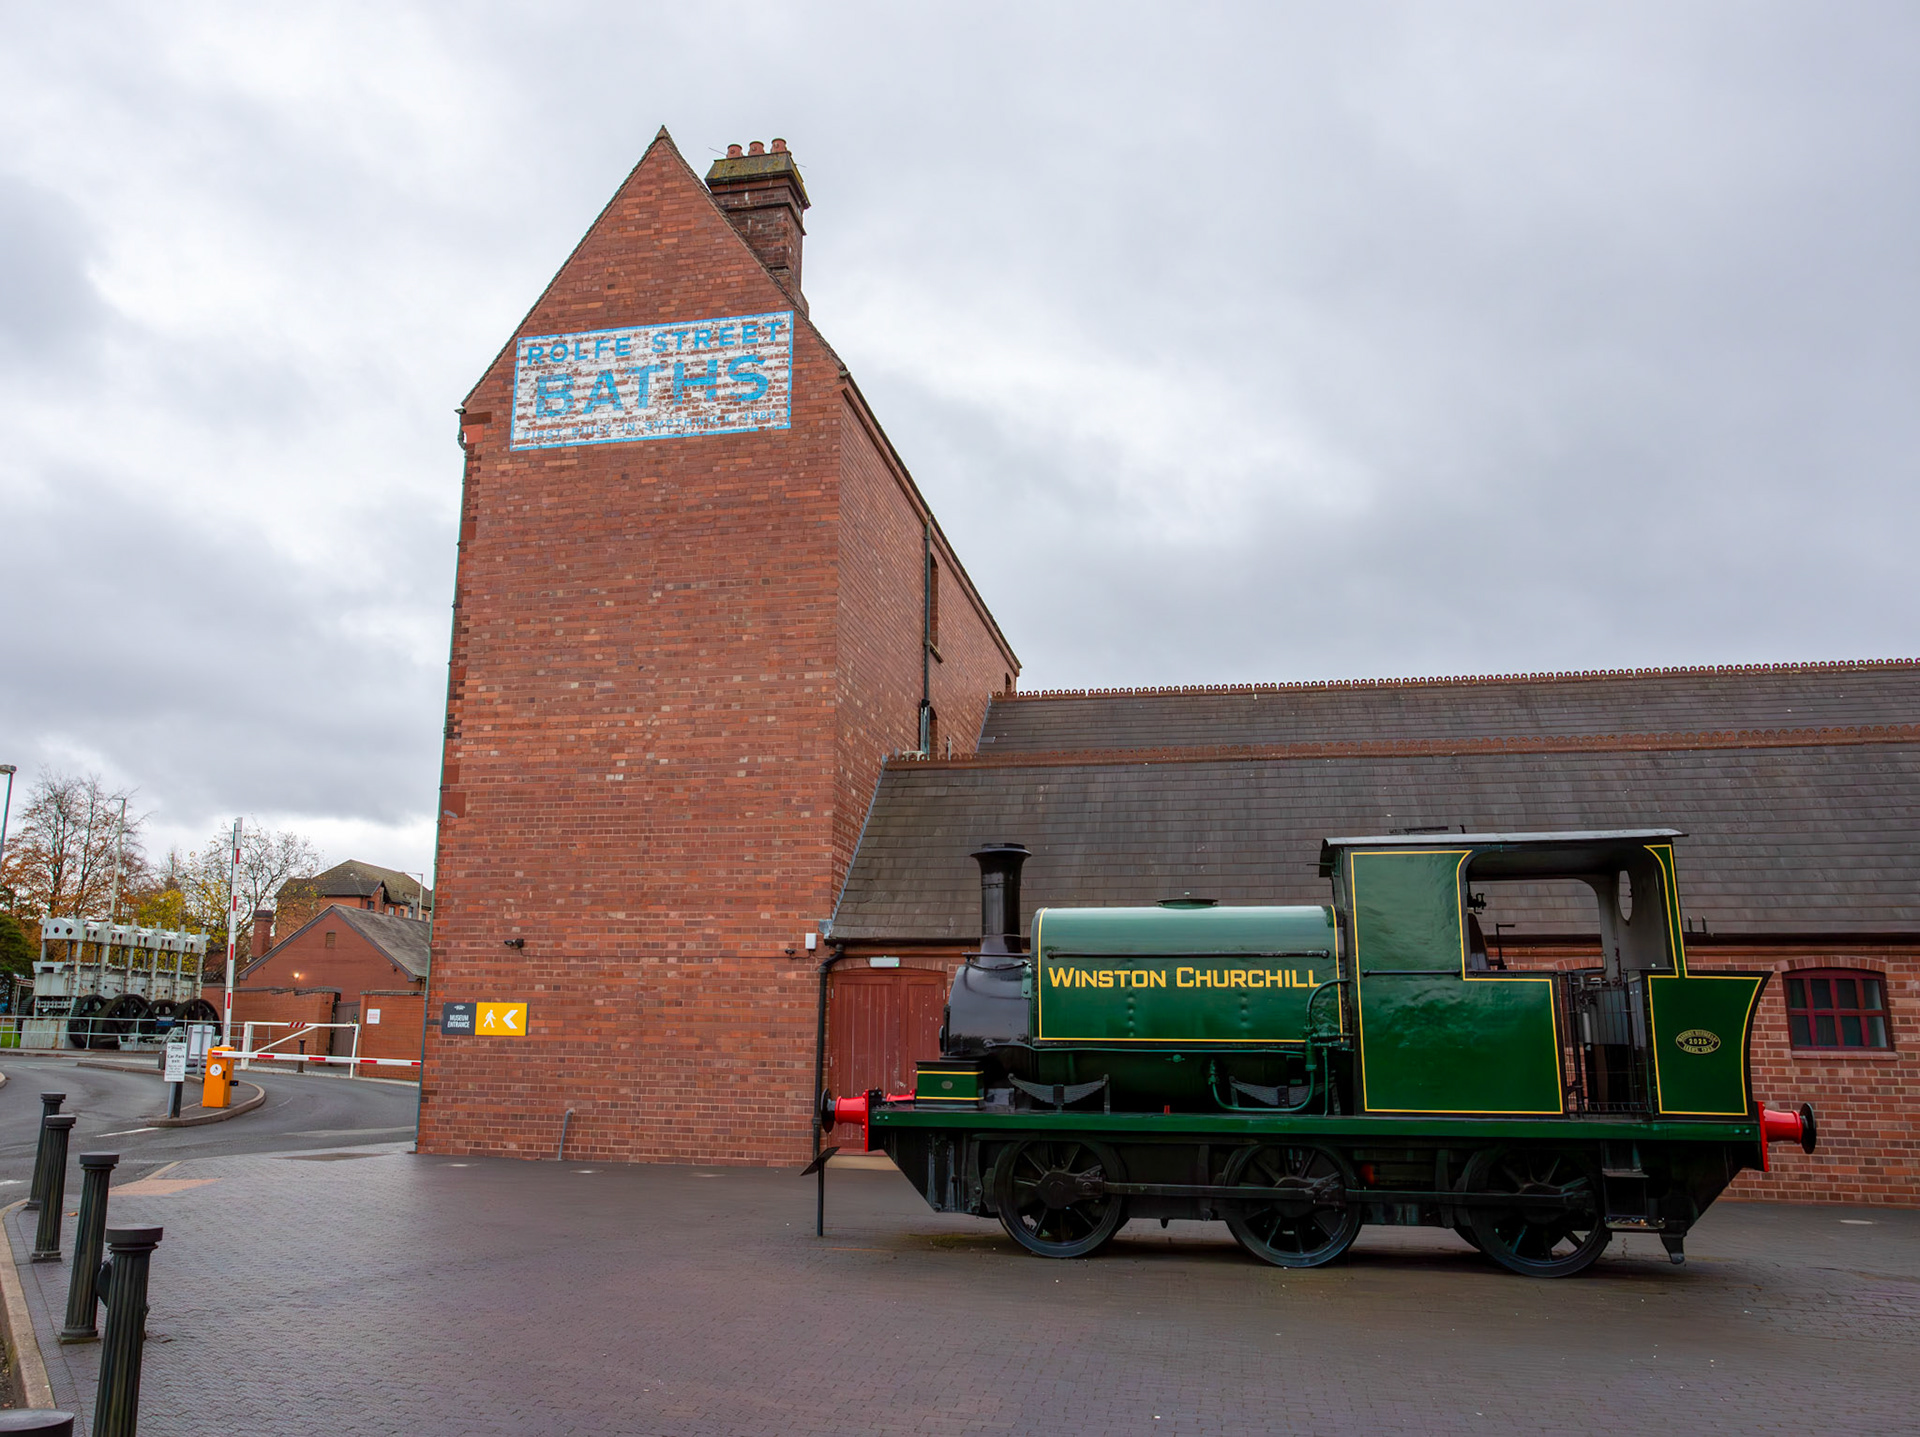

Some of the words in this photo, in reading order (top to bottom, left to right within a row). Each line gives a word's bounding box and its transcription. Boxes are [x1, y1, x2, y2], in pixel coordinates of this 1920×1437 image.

[527, 337, 631, 366] ROLFE
[651, 321, 783, 354] STREET
[535, 354, 769, 419] BATHS
[524, 428, 563, 440] FIRST
[572, 423, 612, 437] BUILT
[621, 423, 636, 432] IN
[449, 1014, 469, 1022] MUSEUM
